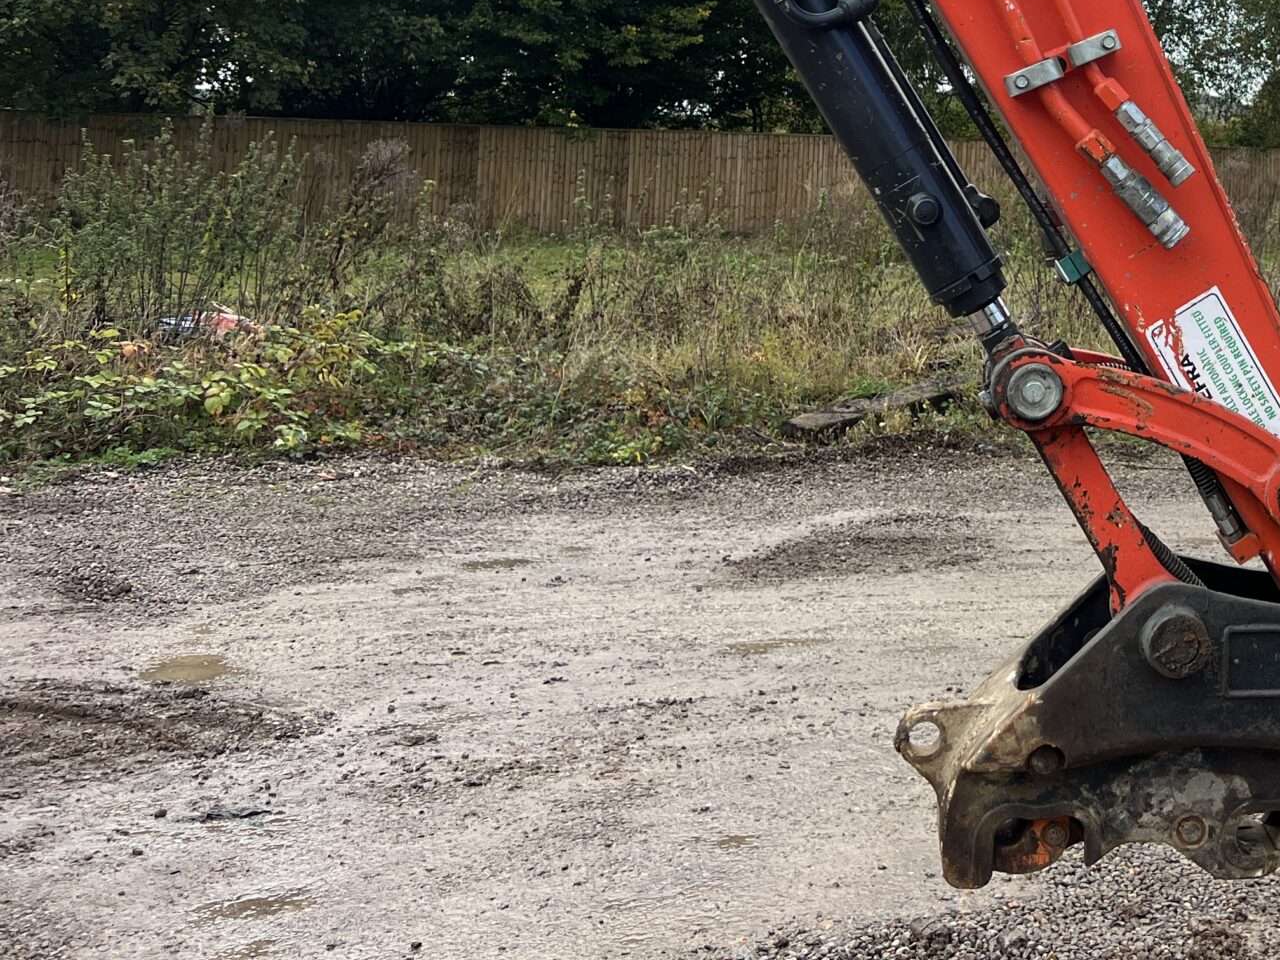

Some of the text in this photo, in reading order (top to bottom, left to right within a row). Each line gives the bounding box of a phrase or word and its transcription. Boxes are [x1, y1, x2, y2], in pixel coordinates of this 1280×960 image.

[1180, 353, 1212, 398] EFRA
[1192, 310, 1265, 427] UBLE LOCKING COUPLER FITTED
[1197, 348, 1239, 412] ULLY AUTOMATIC
[1212, 315, 1277, 420] NO SAFETY PIN REQUIRED
